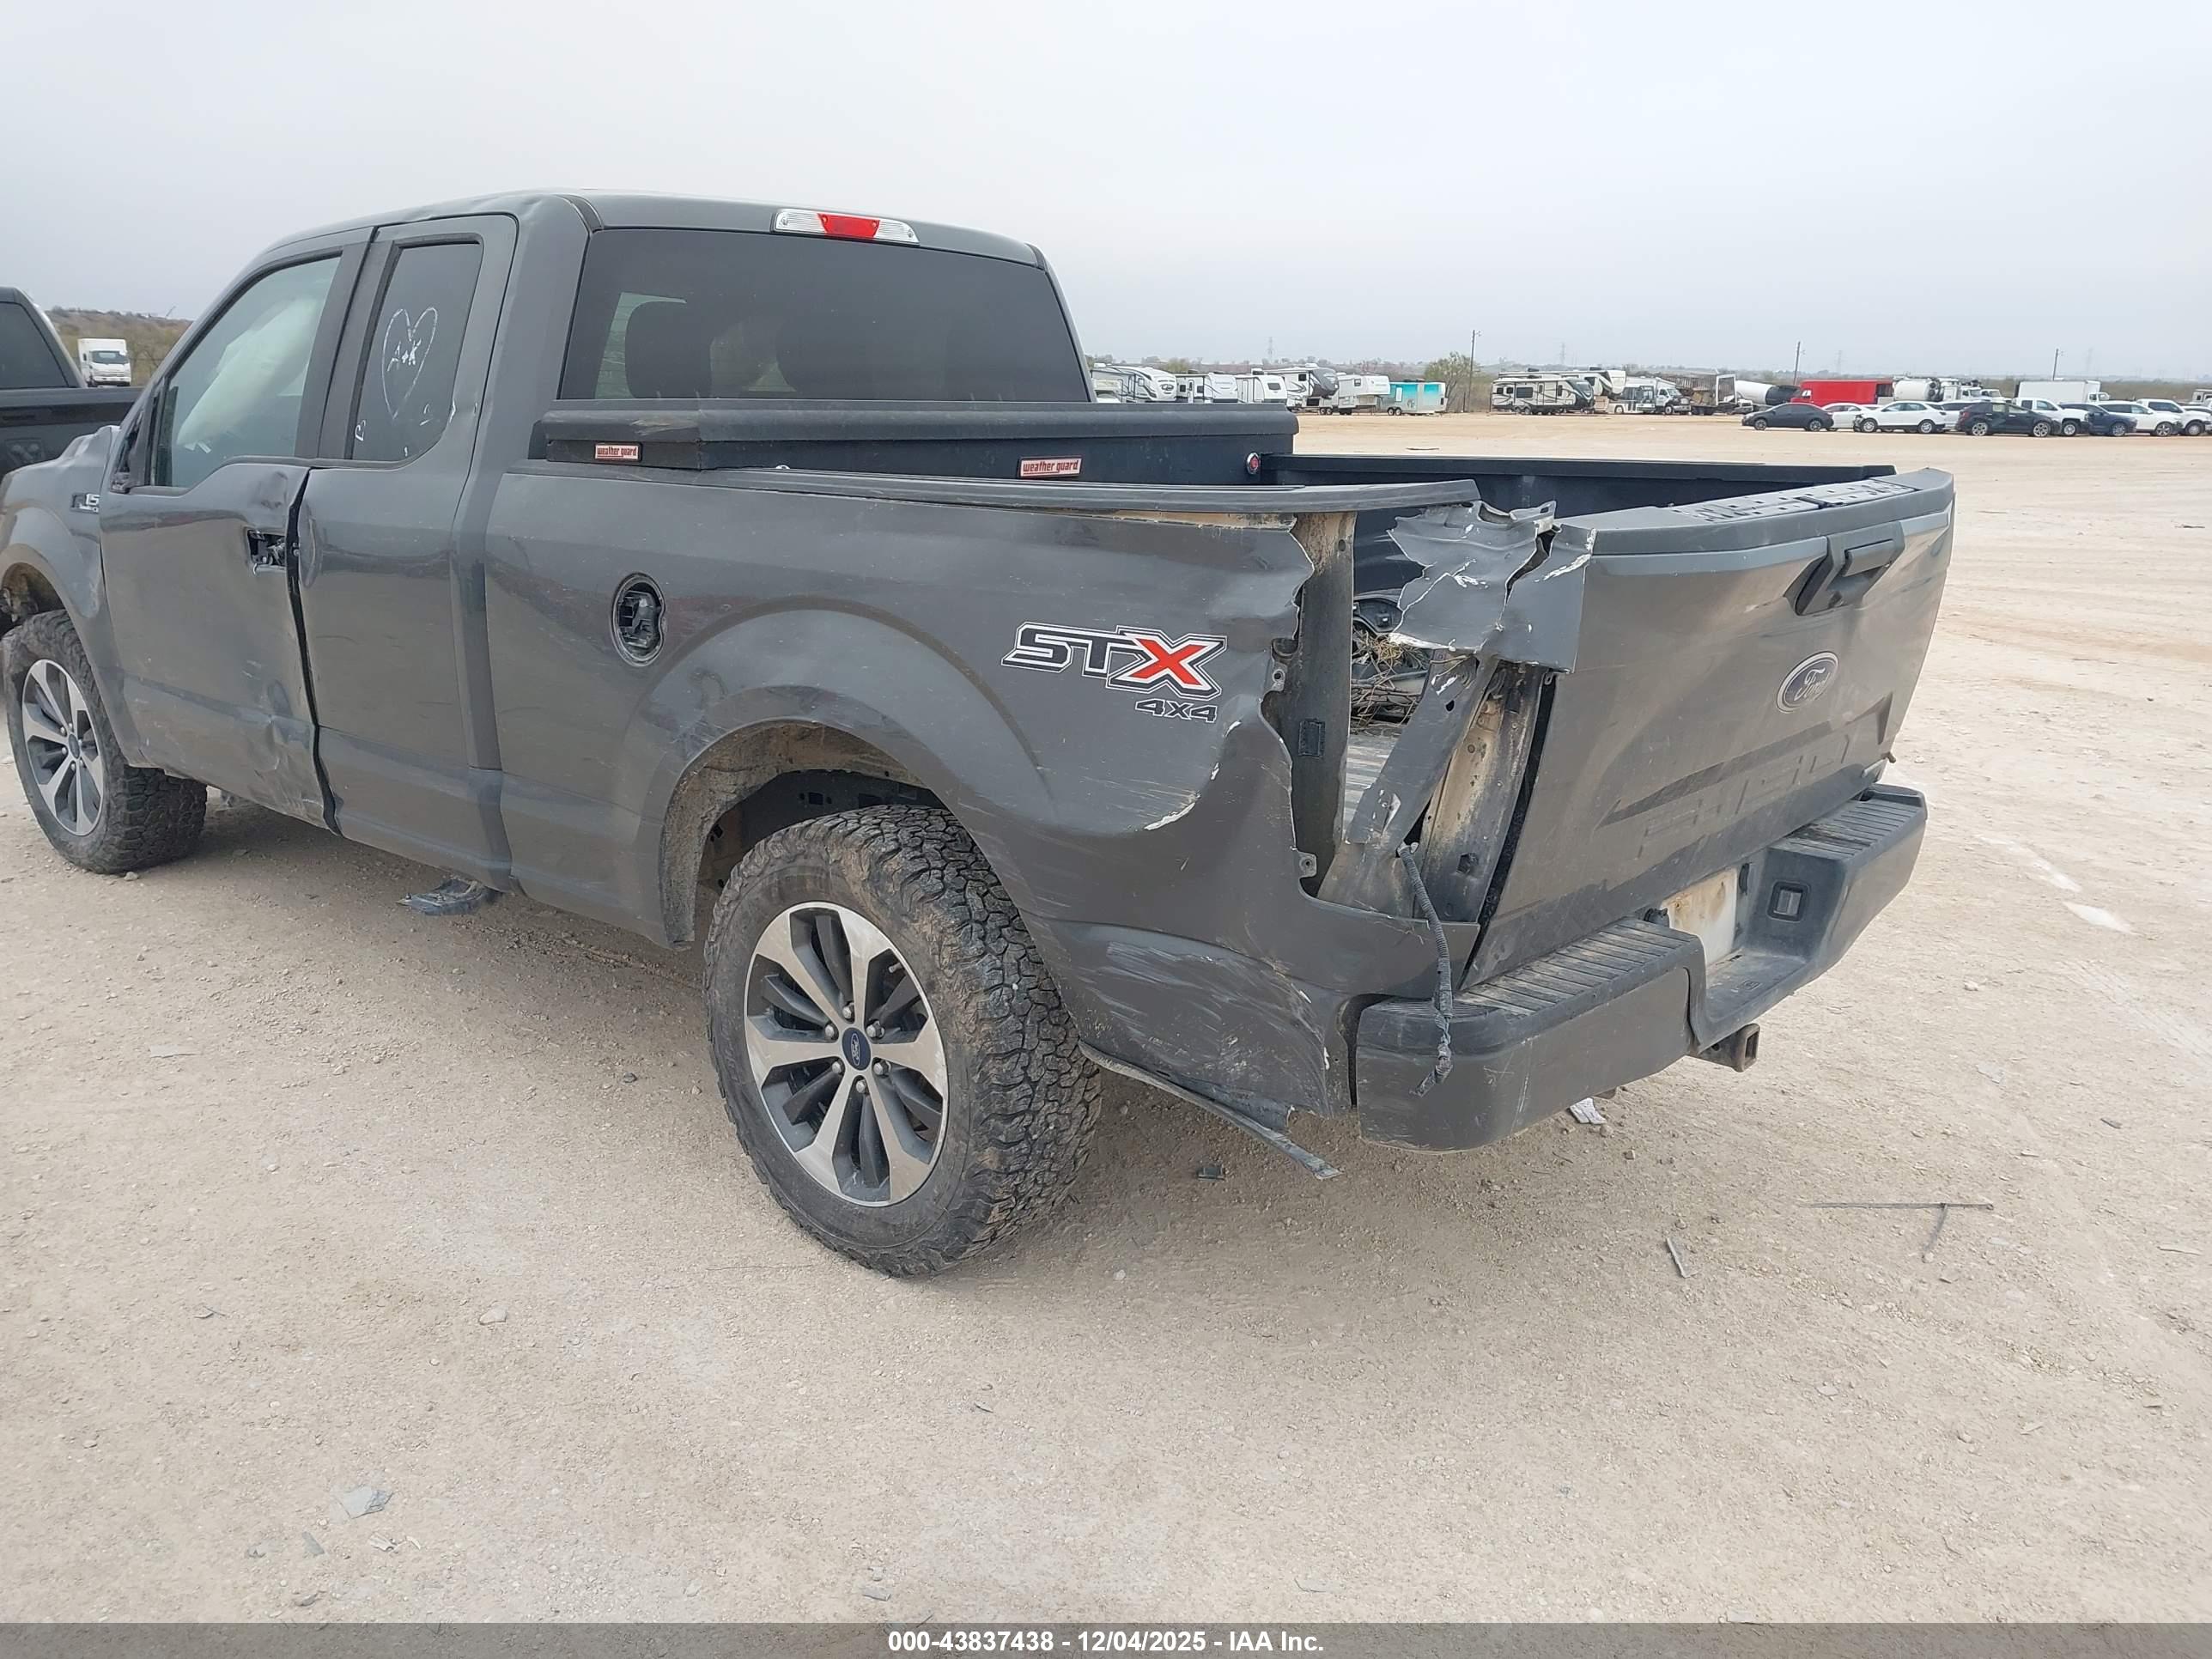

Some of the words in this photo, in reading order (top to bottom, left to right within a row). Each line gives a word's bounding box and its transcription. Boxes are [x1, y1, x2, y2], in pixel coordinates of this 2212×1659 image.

[597, 446, 620, 455] weather
[621, 447, 637, 457] guard
[1023, 460, 1055, 472] weather
[1056, 459, 1079, 473] guard
[1001, 622, 1228, 701] STX
